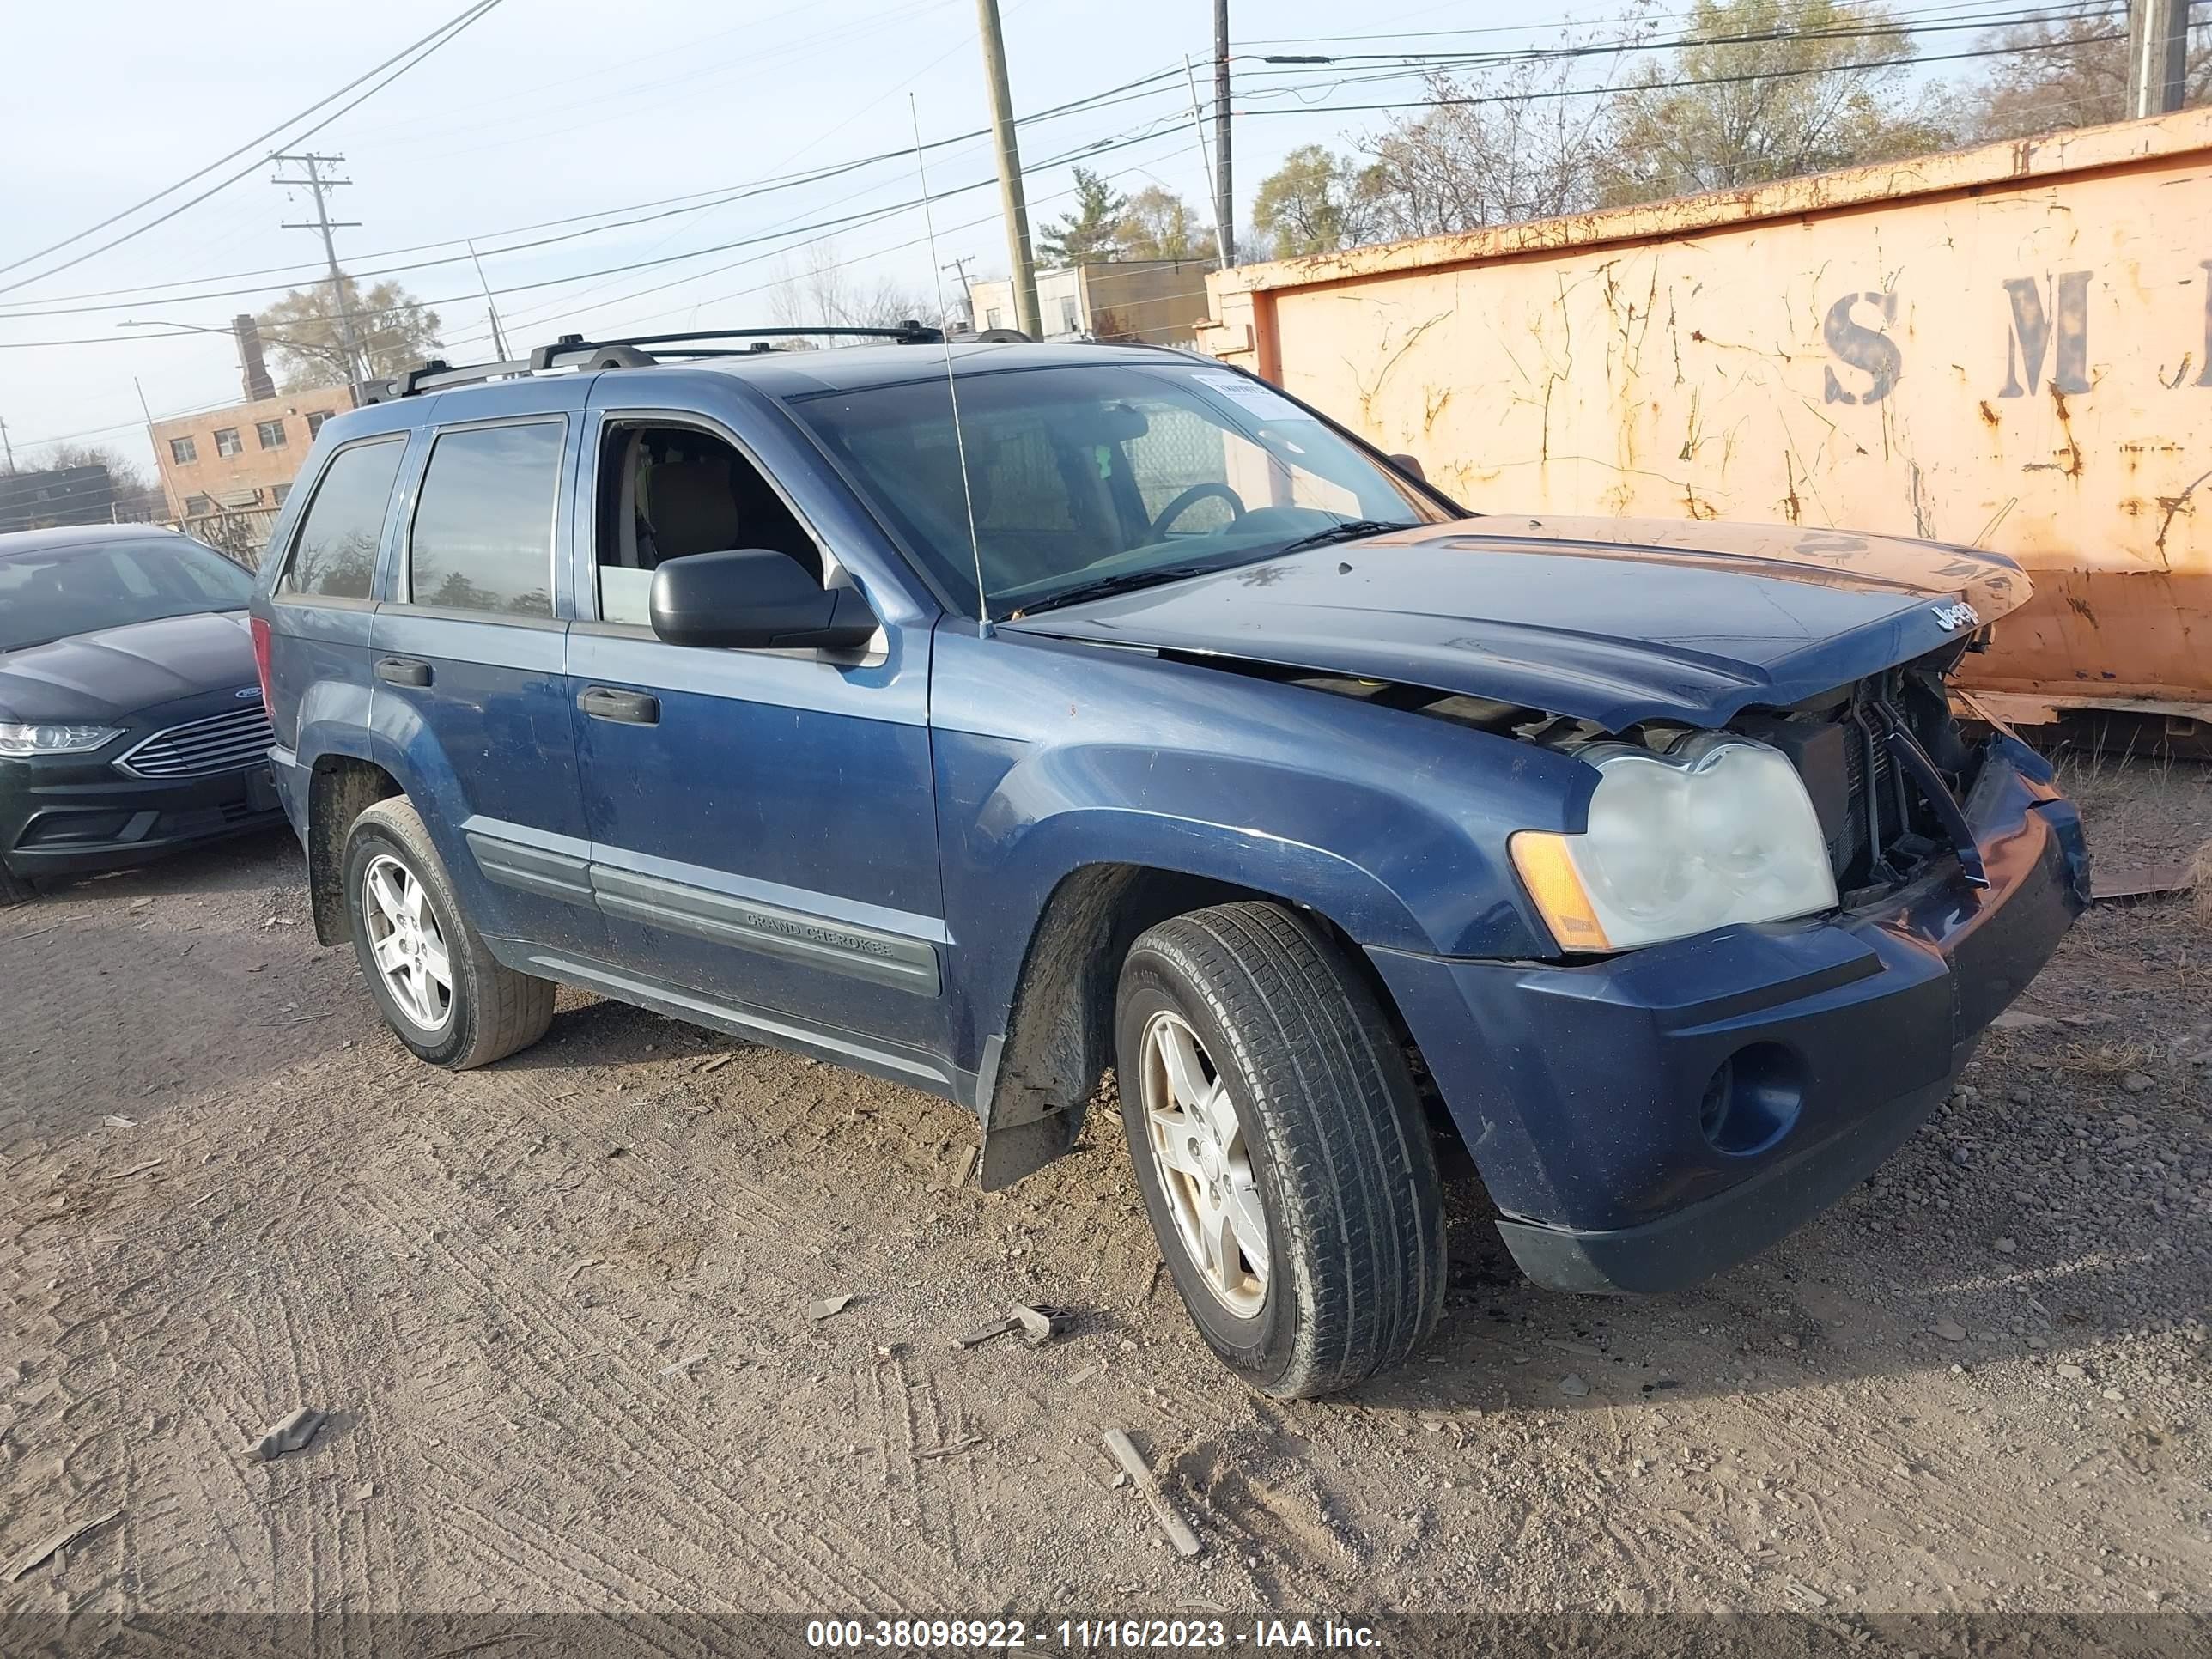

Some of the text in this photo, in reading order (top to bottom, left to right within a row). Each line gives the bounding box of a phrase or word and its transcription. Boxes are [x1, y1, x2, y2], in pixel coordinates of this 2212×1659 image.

[1931, 602, 1979, 629] Jeep
[747, 914, 894, 957] GRAND CHEROKEE
